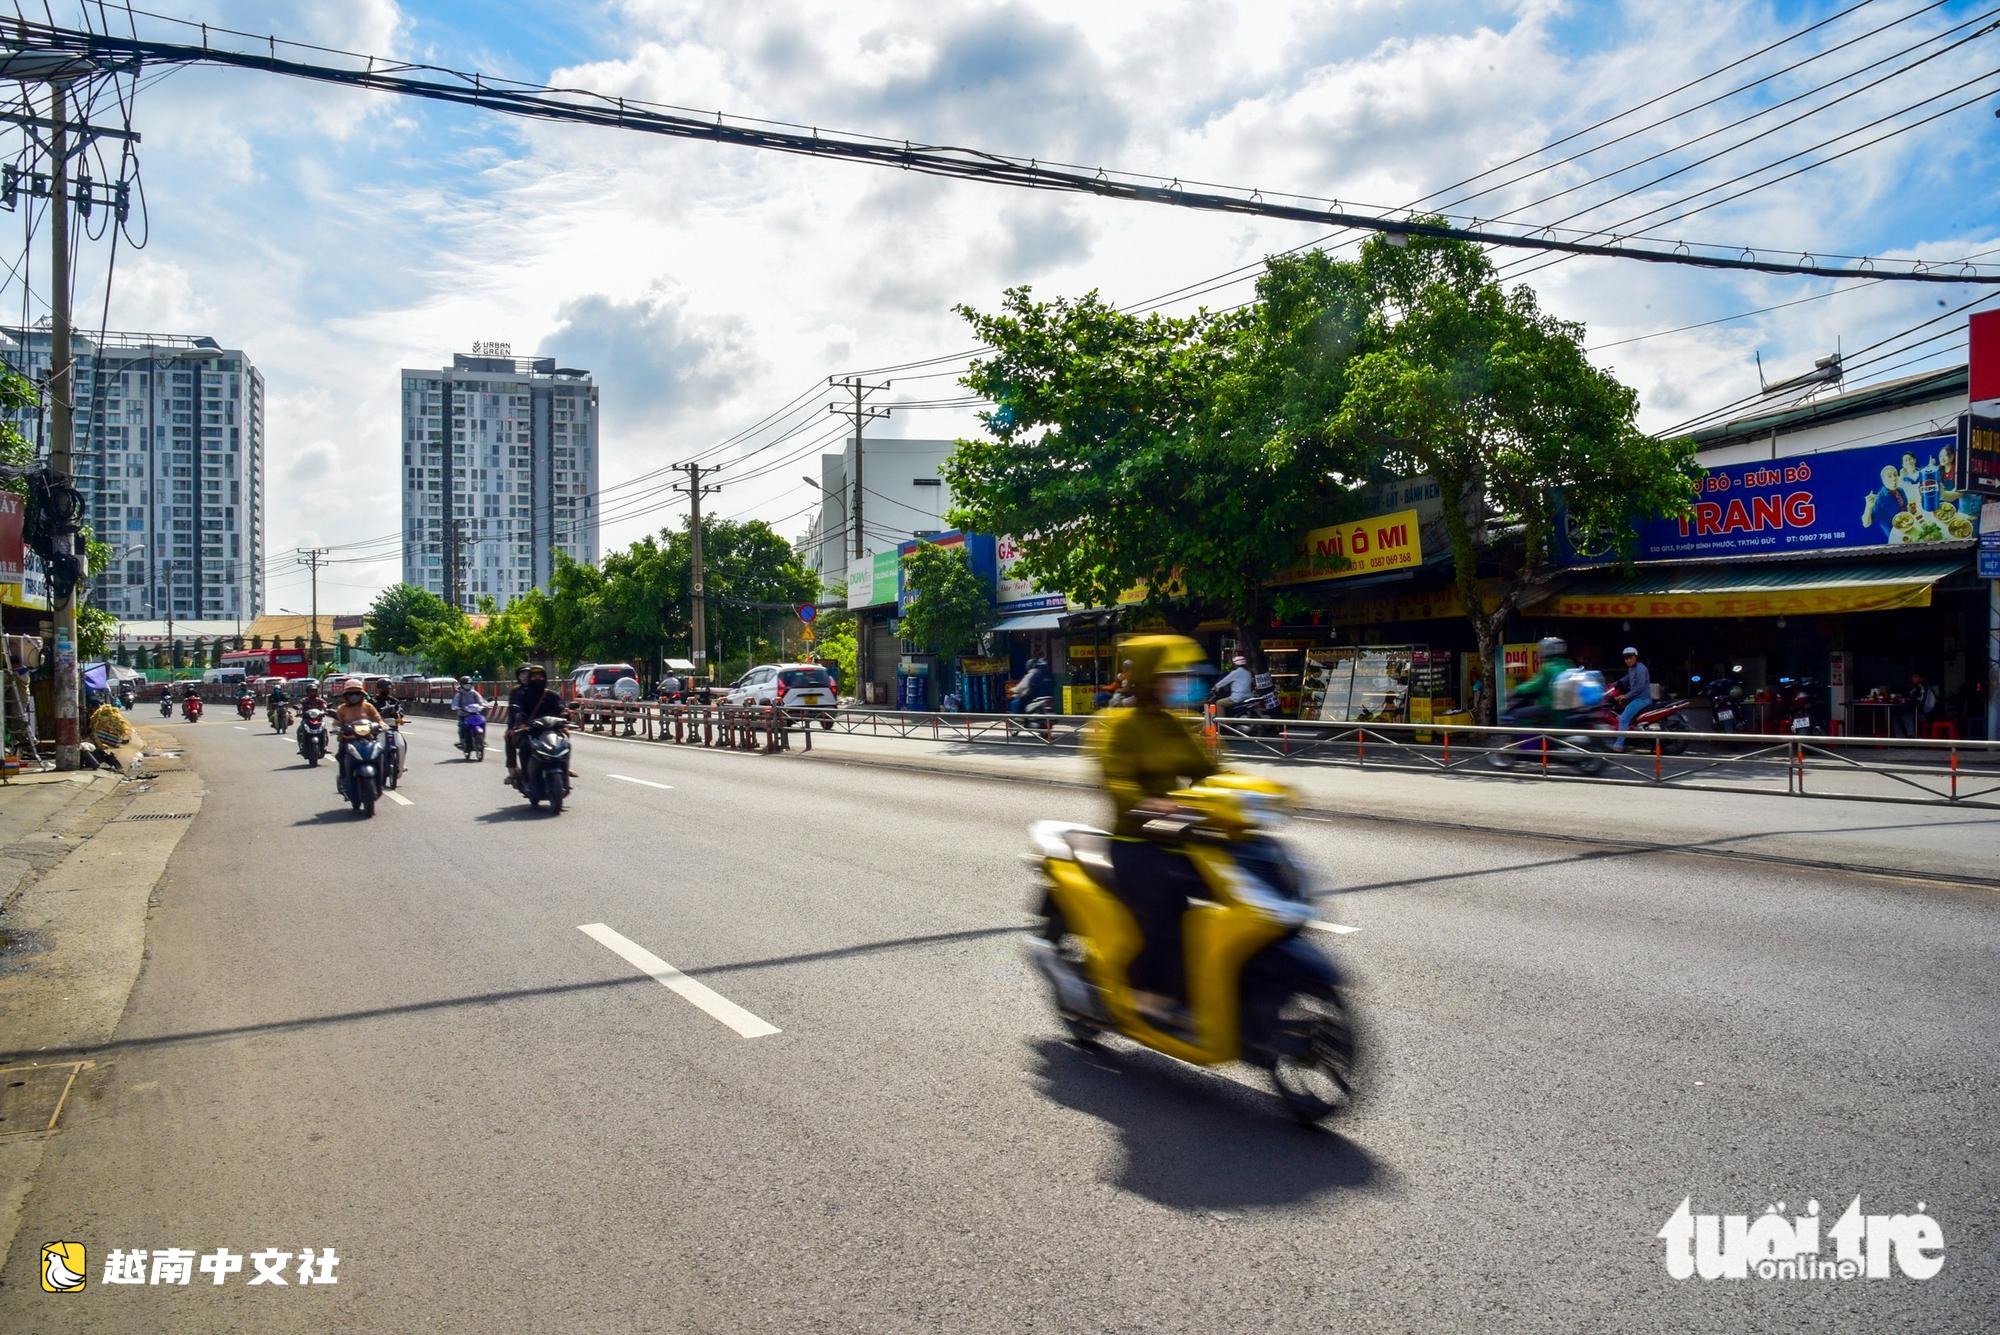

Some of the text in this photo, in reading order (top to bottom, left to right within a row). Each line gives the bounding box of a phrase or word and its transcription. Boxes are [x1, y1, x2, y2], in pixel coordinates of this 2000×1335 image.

[483, 341, 511, 349] URBAN
[483, 348, 511, 356] GREEN
[1707, 472, 1731, 493] BÒ
[1744, 467, 1781, 488] BÚN
[1785, 461, 1812, 482] BÒ
[1679, 491, 1816, 537] TRANG
[1317, 529, 1345, 557] MÌ
[1351, 526, 1370, 555] Ô
[1377, 523, 1409, 550] MI
[1761, 535, 1776, 545] ĐỨC
[1786, 535, 1798, 543] ĐT:
[1799, 534, 1817, 542] 0907
[1818, 532, 1832, 540] 798
[1833, 531, 1846, 539] 188
[1370, 556, 1385, 568] 0387
[1386, 553, 1398, 565] 069
[1399, 552, 1412, 563] 368
[1563, 595, 1637, 616] PHỞ
